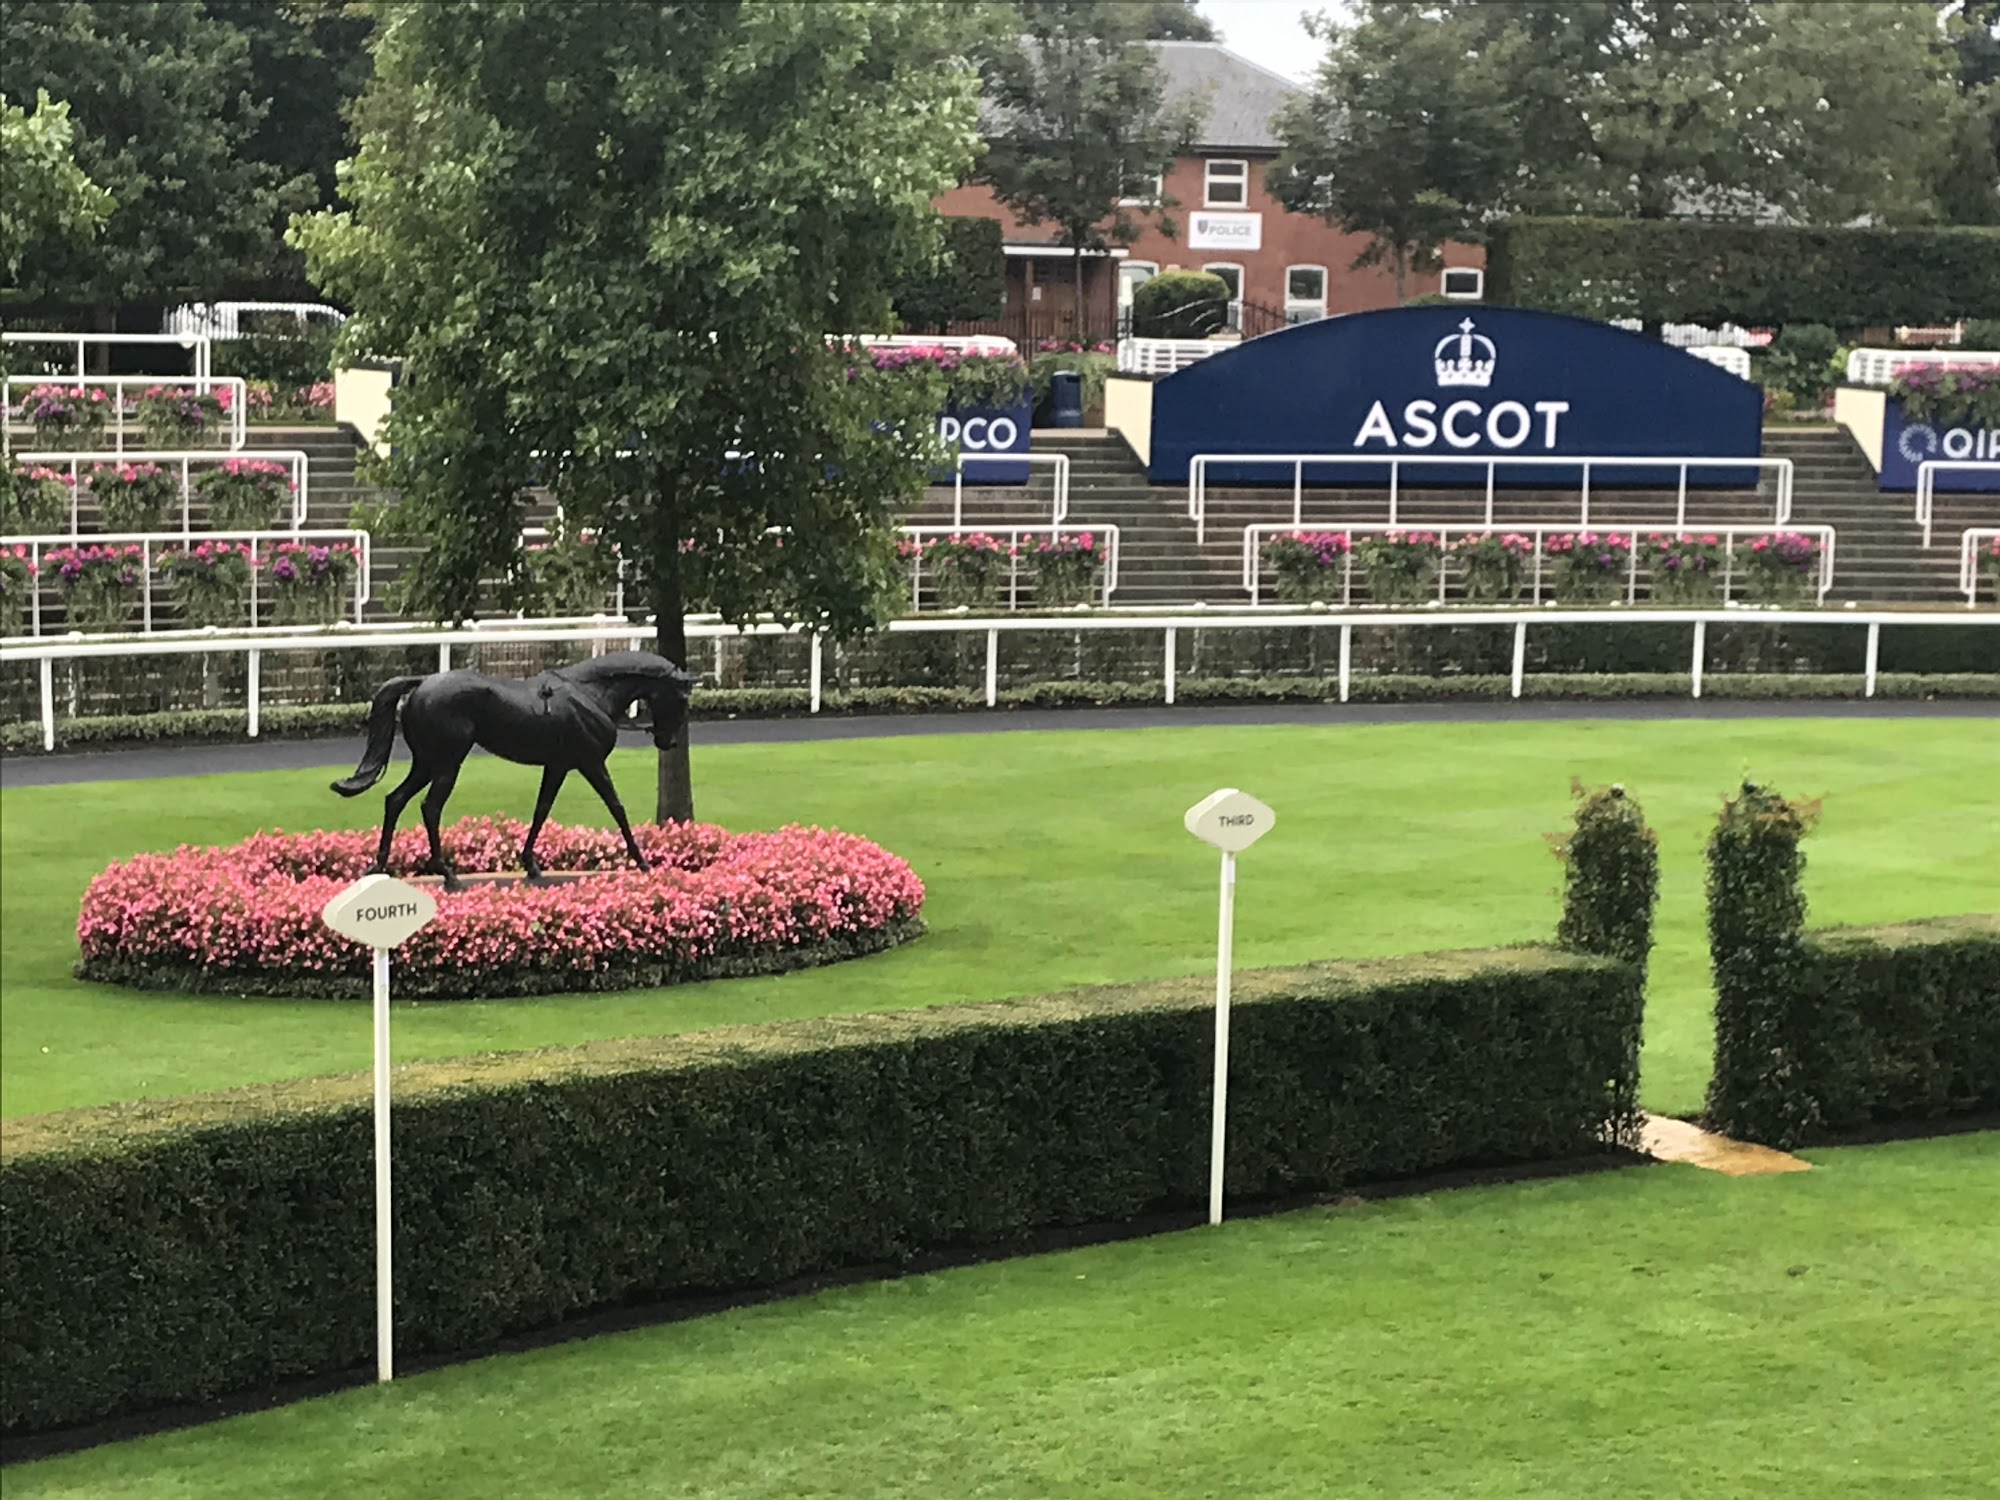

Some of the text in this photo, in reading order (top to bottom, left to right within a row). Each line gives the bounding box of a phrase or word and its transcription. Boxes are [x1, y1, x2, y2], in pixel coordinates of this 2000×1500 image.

[1209, 225, 1251, 236] POLICE
[1353, 399, 1570, 449] ASCOT
[1219, 813, 1255, 827] THIRD
[356, 902, 417, 922] FOURTH
